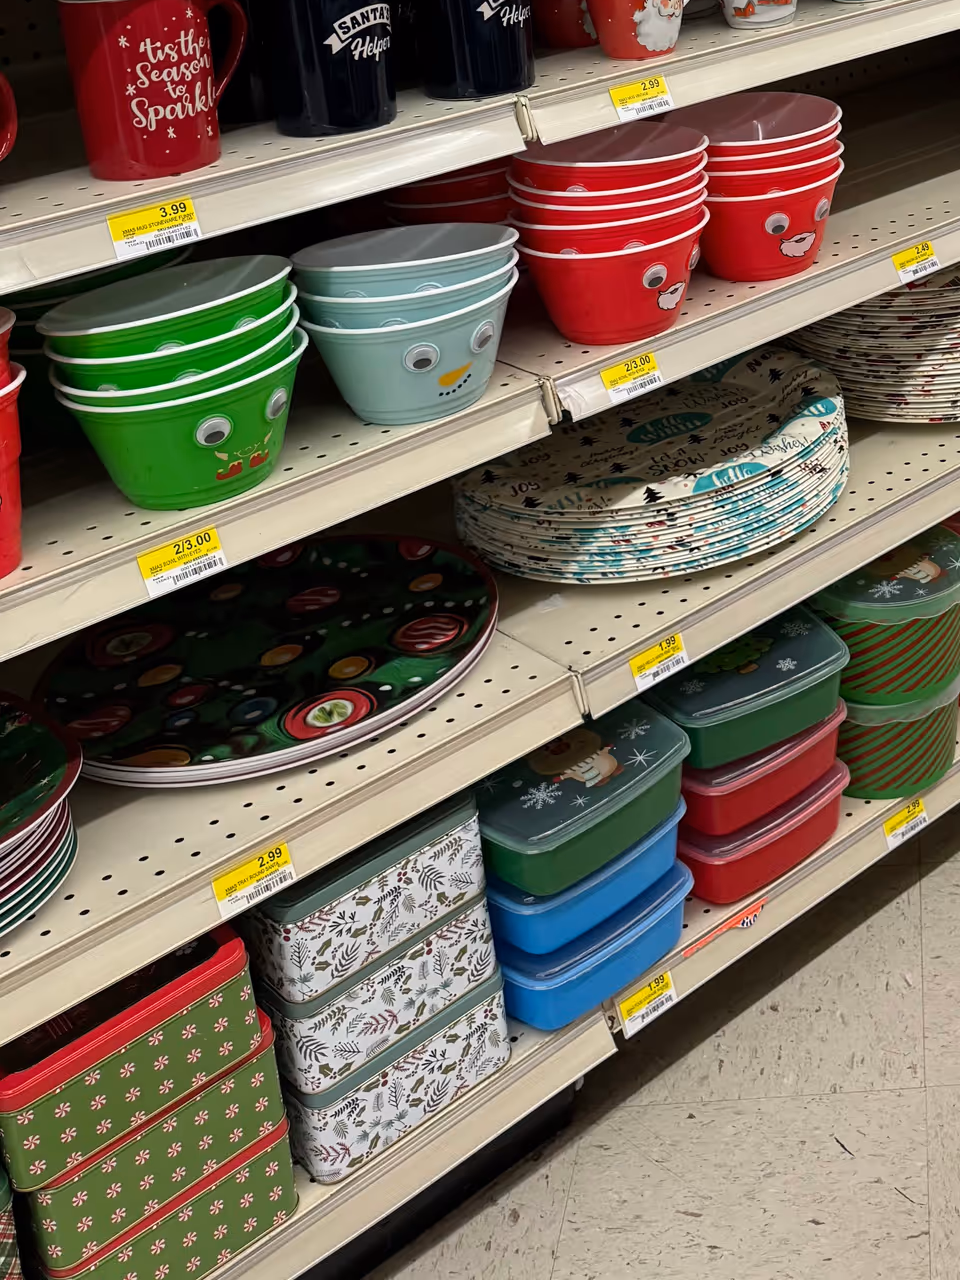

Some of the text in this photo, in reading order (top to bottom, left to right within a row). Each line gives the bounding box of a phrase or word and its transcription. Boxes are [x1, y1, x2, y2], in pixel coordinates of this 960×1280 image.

[338, 5, 391, 37] SANTA'S
[139, 28, 206, 64] 'tis the
[350, 35, 391, 62] Helper
[136, 53, 211, 89] Season
[164, 81, 187, 99] to
[640, 78, 660, 92] 2.99
[159, 202, 187, 218] 3.99
[122, 212, 194, 236] XMAS MUG STONEWARE FUNNY
[914, 242, 930, 255] 2.49
[624, 355, 651, 373] 2/3.00
[719, 443, 751, 458] JOY
[519, 452, 550, 468] JOY
[648, 451, 705, 478] SNOW
[510, 481, 540, 499] JOY
[173, 532, 212, 555] 2/3.00
[163, 557, 176, 567] BOWL
[177, 552, 189, 563] WITH
[189, 547, 203, 557] EYES
[658, 635, 676, 652] 1.99
[906, 799, 920, 814] 2.99
[257, 847, 283, 868] 2.99
[237, 877, 249, 888] TRAY
[249, 869, 265, 881] ROUND
[265, 861, 280, 873] SANTA
[648, 974, 666, 992] 1.99
